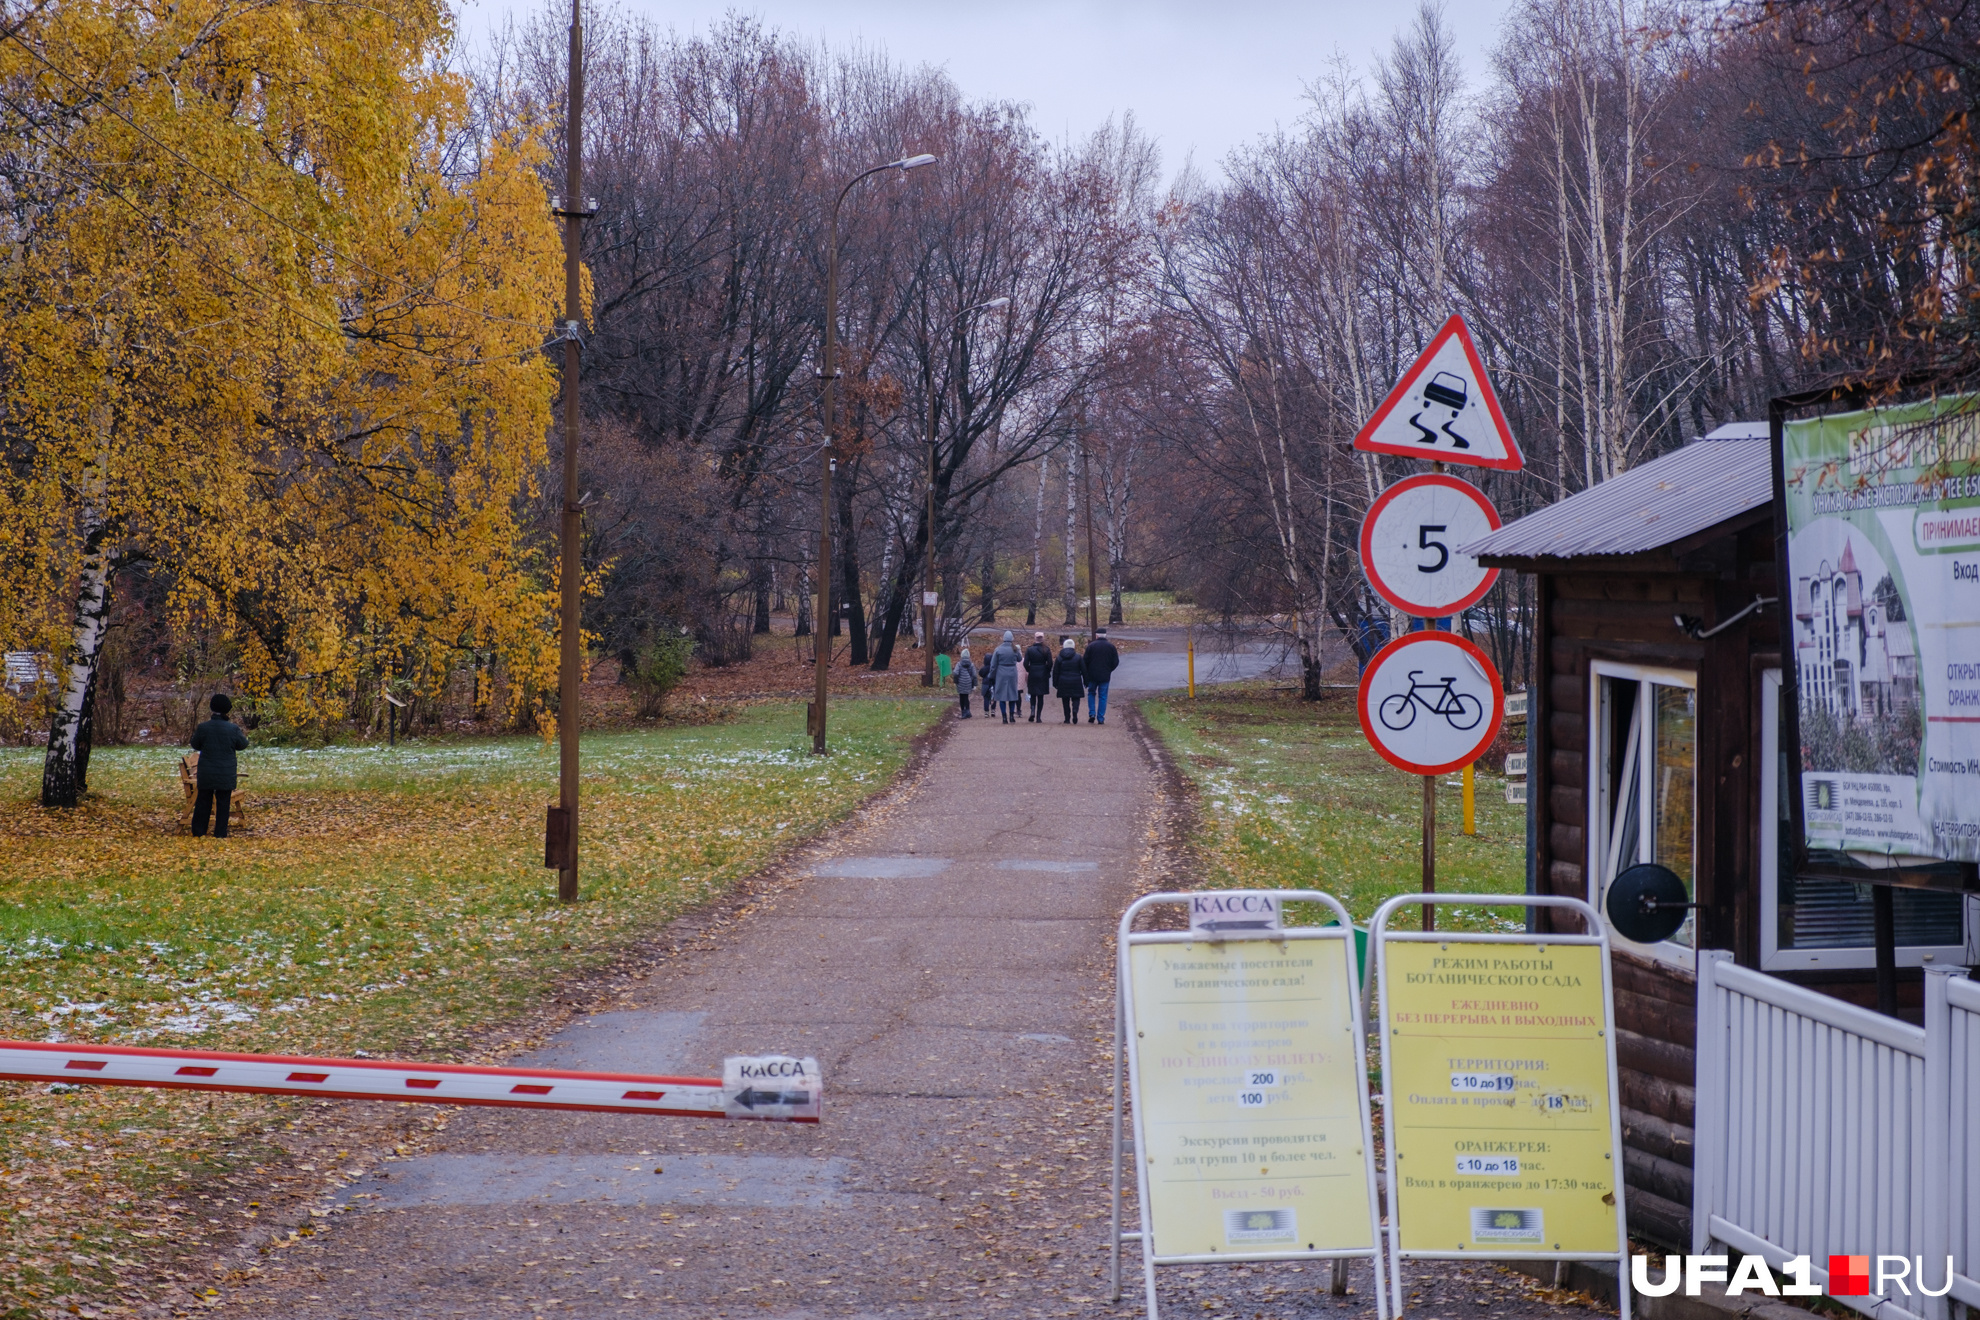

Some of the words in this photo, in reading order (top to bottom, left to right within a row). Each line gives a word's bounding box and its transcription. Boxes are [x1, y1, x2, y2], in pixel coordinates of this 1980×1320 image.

[1813, 488, 1871, 514] УНИКАЛЬНЫЕ
[1923, 516, 1980, 541] ПРИНИМАЕ
[1417, 525, 1449, 573] 5
[1954, 561, 1979, 583] Вход
[1929, 757, 1966, 775] Стоимость
[1967, 757, 1980, 776] ИН
[1934, 821, 1945, 835] НА
[1194, 896, 1274, 913] КАССА
[1163, 959, 1236, 971] Уважаемые
[1241, 958, 1313, 969] посетители
[1433, 957, 1489, 970] РЕЖИМ
[1494, 959, 1553, 971] РАБОТЫ
[1174, 977, 1269, 989] Ботанического
[1273, 975, 1305, 987] сада!
[1406, 973, 1538, 986] БОТАНИЧЕСКОГО
[1542, 975, 1582, 987] САДА
[1451, 999, 1539, 1011] ЕЖЕДНЕВНО
[1178, 1020, 1208, 1032] Вход
[1212, 1022, 1226, 1030] на
[1230, 1018, 1309, 1033] территорию
[1396, 1013, 1420, 1023] БЕЗ
[1424, 1013, 1497, 1025] ПЕРЕРЫВА
[1501, 1015, 1510, 1025] И
[1515, 1015, 1596, 1027] ВЫХОДНЫХ
[1210, 1040, 1217, 1048] в
[1221, 1038, 1293, 1050] оранжерею
[1161, 1056, 1183, 1068] ПО
[1187, 1054, 1262, 1068] ЕДИНОМУ
[1267, 1053, 1332, 1066] БИЛЕТУ:
[1447, 1058, 1550, 1071] ТЕРРИТОРИЯ:
[740, 1061, 805, 1078] КАССА
[1252, 1073, 1274, 1085] 200
[1463, 1076, 1477, 1088] 10
[1480, 1080, 1494, 1089] до
[1495, 1076, 1514, 1091] 19
[1206, 1094, 1234, 1104] дети
[1240, 1093, 1262, 1104] 100
[1409, 1094, 1457, 1105] Оплата
[1461, 1096, 1469, 1104] и
[1475, 1096, 1516, 1108] проход
[1531, 1098, 1545, 1107] до
[1548, 1096, 1563, 1108] 18
[1178, 1136, 1249, 1149] Экскурсии
[1253, 1133, 1327, 1147] проводятся
[1454, 1140, 1551, 1152] ОРАНЖЕРЕЯ:
[1173, 1155, 1196, 1166] для
[1200, 1154, 1238, 1167] групп
[1241, 1152, 1255, 1163] 10
[1260, 1154, 1267, 1162] и
[1271, 1151, 1306, 1162] более
[1310, 1150, 1336, 1161] чел.
[1467, 1159, 1481, 1170] 10
[1485, 1162, 1499, 1171] до
[1502, 1160, 1517, 1171] 18
[1520, 1162, 1545, 1171] час.
[1405, 1177, 1434, 1188] Вход
[1439, 1180, 1446, 1188] в
[1450, 1180, 1521, 1191] оранжерею
[1526, 1181, 1540, 1190] до
[1544, 1178, 1577, 1190] 17:30
[1581, 1181, 1607, 1190] час.
[1212, 1188, 1249, 1200] Въезд
[1261, 1186, 1275, 1198] 50
[1279, 1185, 1304, 1200] руб.
[1475, 1230, 1526, 1238] БОТАНИЧЕСКИЙ
[1527, 1230, 1541, 1238] САД
